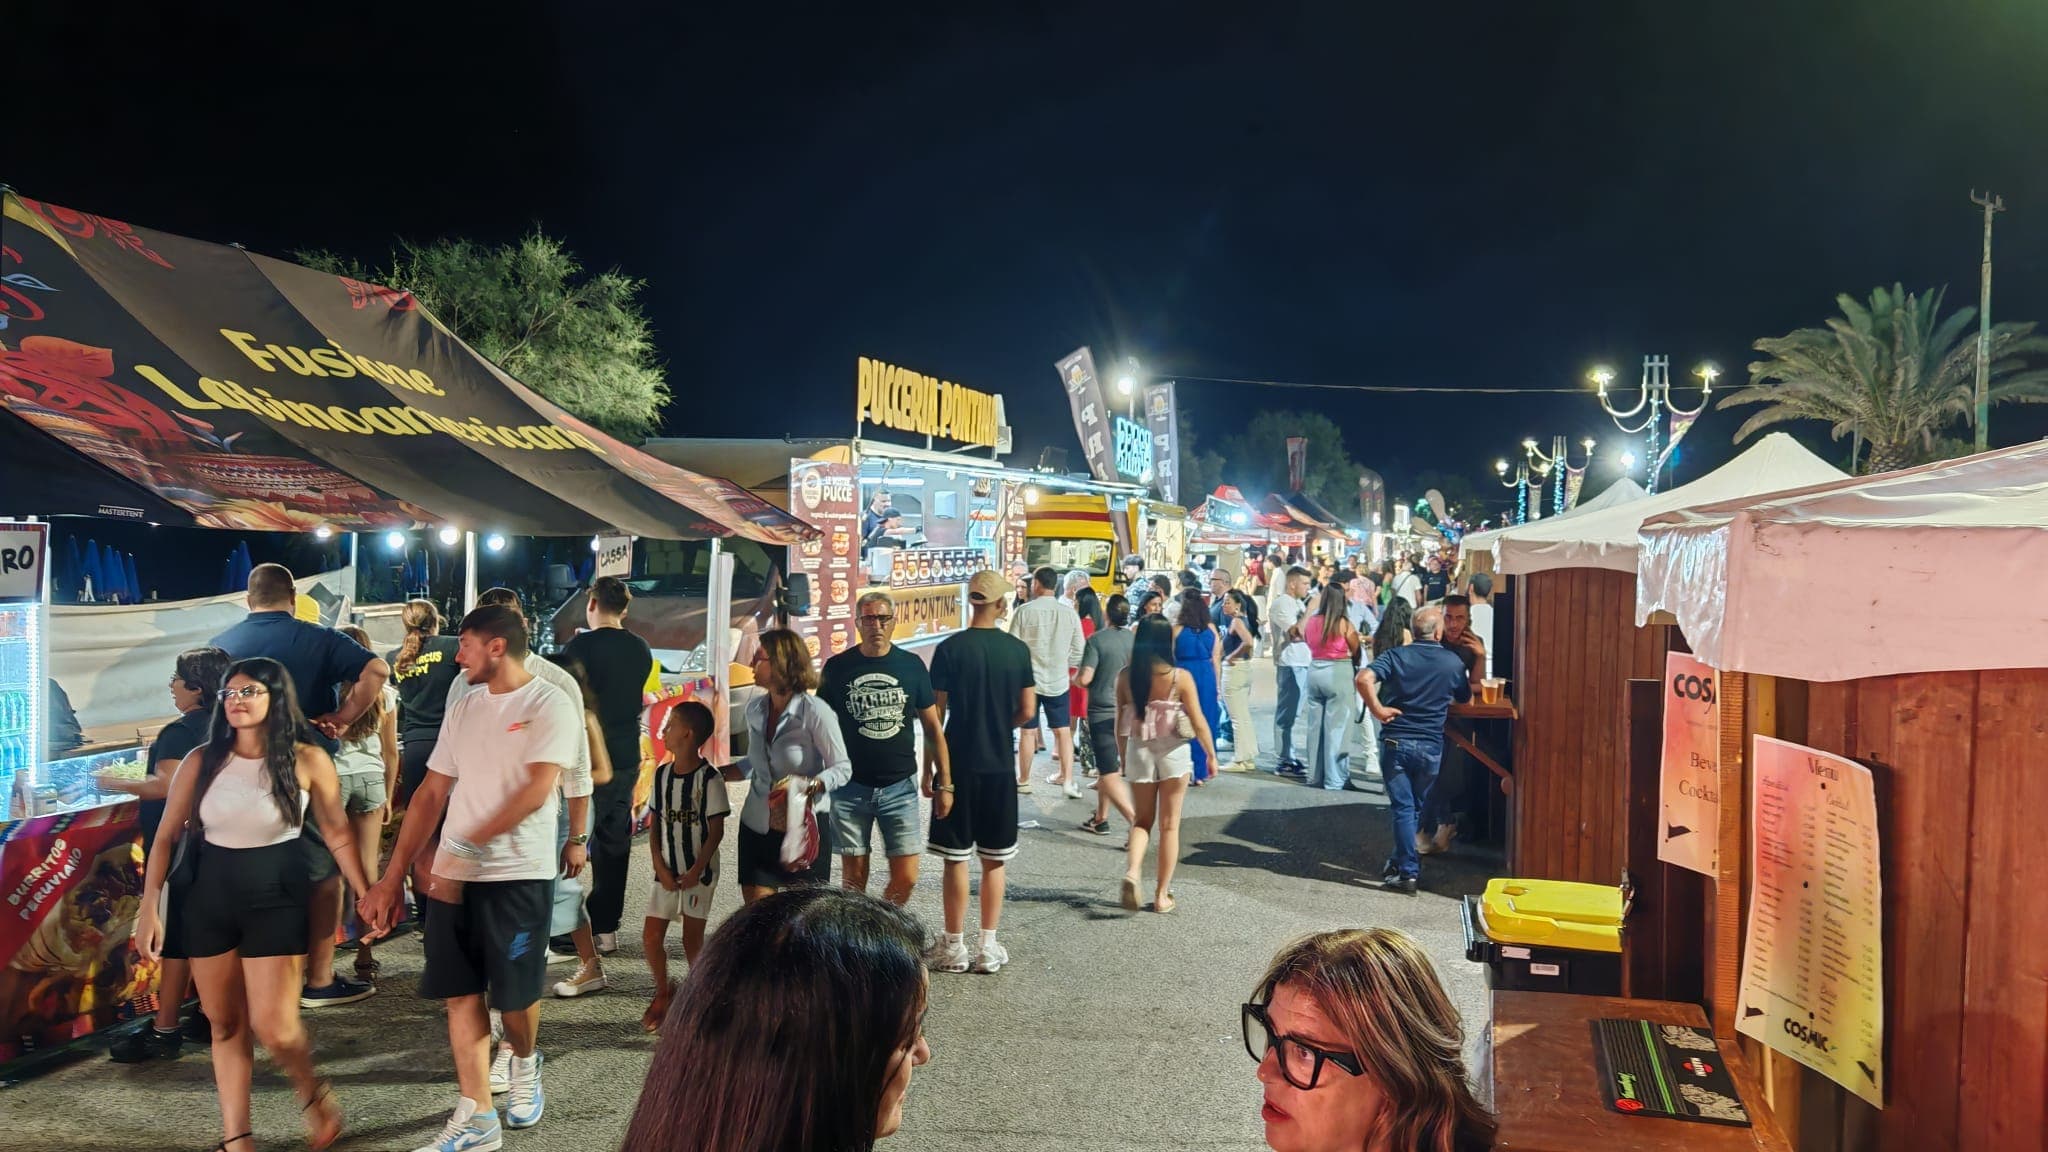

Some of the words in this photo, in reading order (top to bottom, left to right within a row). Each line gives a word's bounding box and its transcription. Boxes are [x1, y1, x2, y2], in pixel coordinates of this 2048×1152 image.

[219, 328, 446, 397] Fusione
[134, 364, 607, 455] Latinoamericano
[857, 356, 938, 436] PUCCERIA
[939, 380, 998, 447] PONTINA
[822, 485, 853, 502] PUCCE
[98, 507, 144, 518] MASTERTENT
[0, 545, 34, 574] RO
[913, 594, 956, 621] PONTINA
[415, 650, 443, 665] IRCUS
[849, 687, 907, 720] BARBER
[8, 838, 67, 906] BURRITOS
[1783, 1018, 1828, 1053] COSMIC
